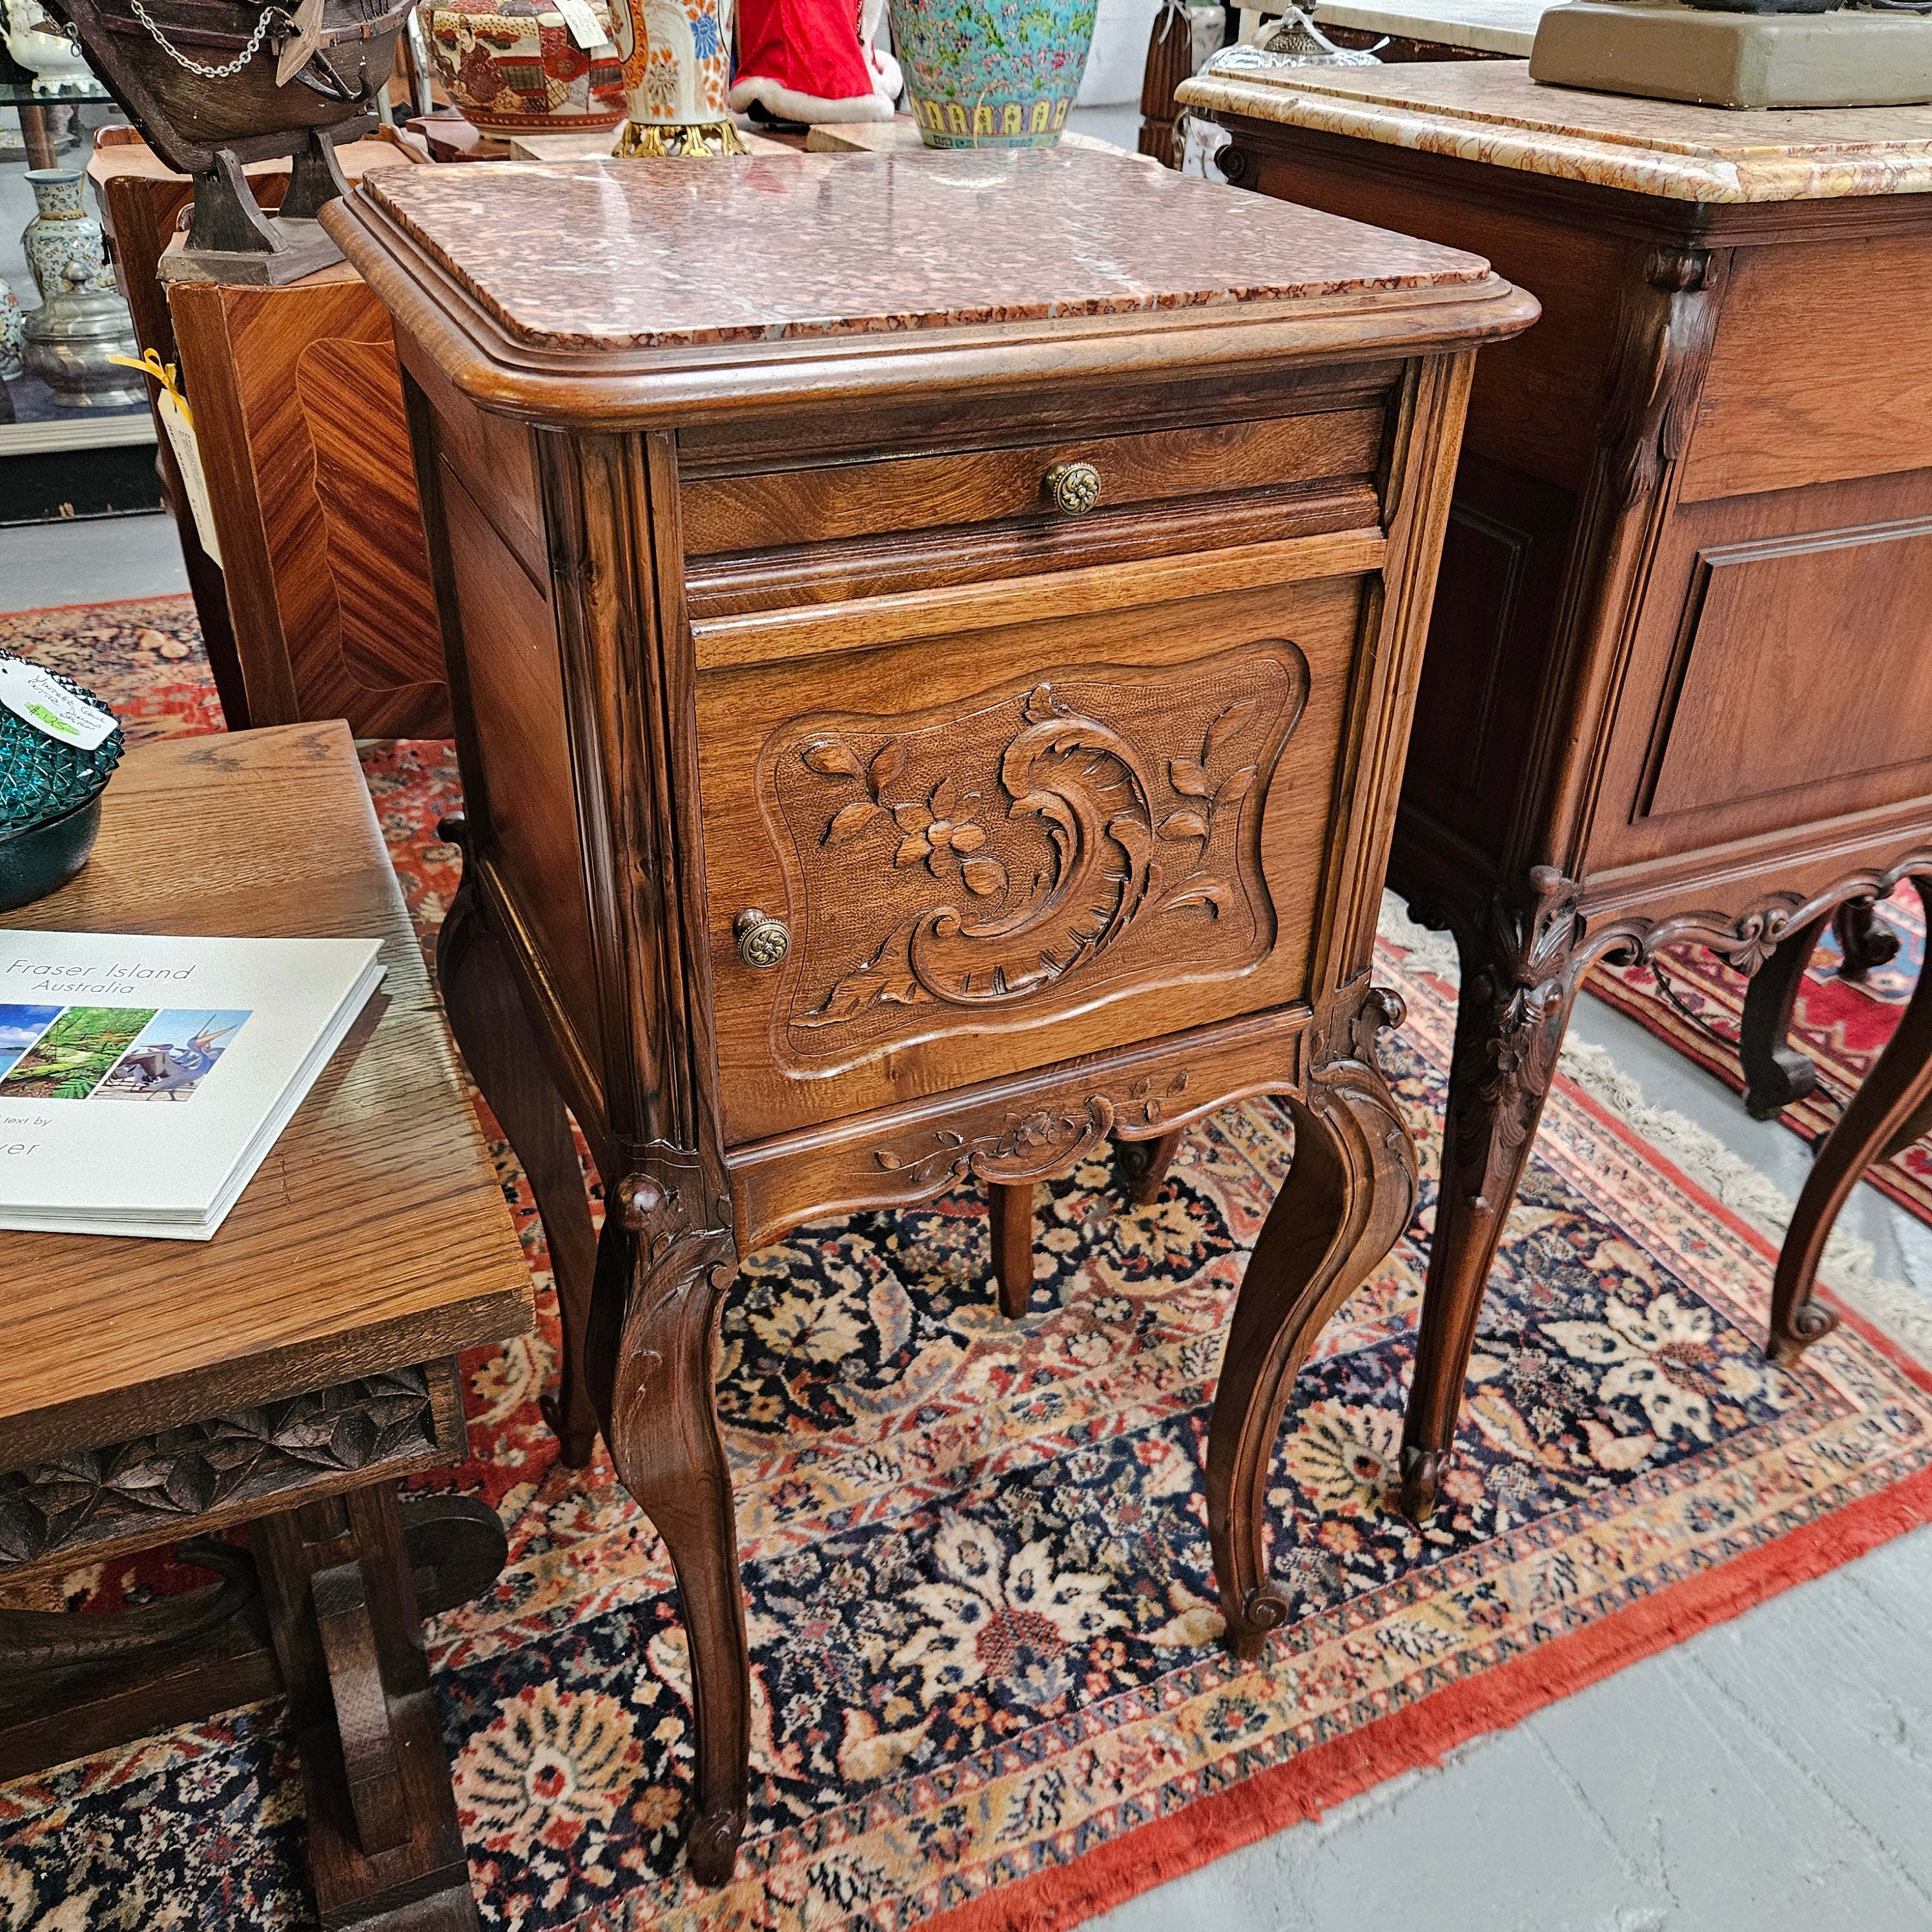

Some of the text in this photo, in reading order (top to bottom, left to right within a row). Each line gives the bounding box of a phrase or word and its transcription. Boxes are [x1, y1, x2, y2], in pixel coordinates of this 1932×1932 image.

[6, 960, 196, 980] Fraser Island
[32, 980, 134, 994] Australia
[34, 1116, 52, 1127] by
